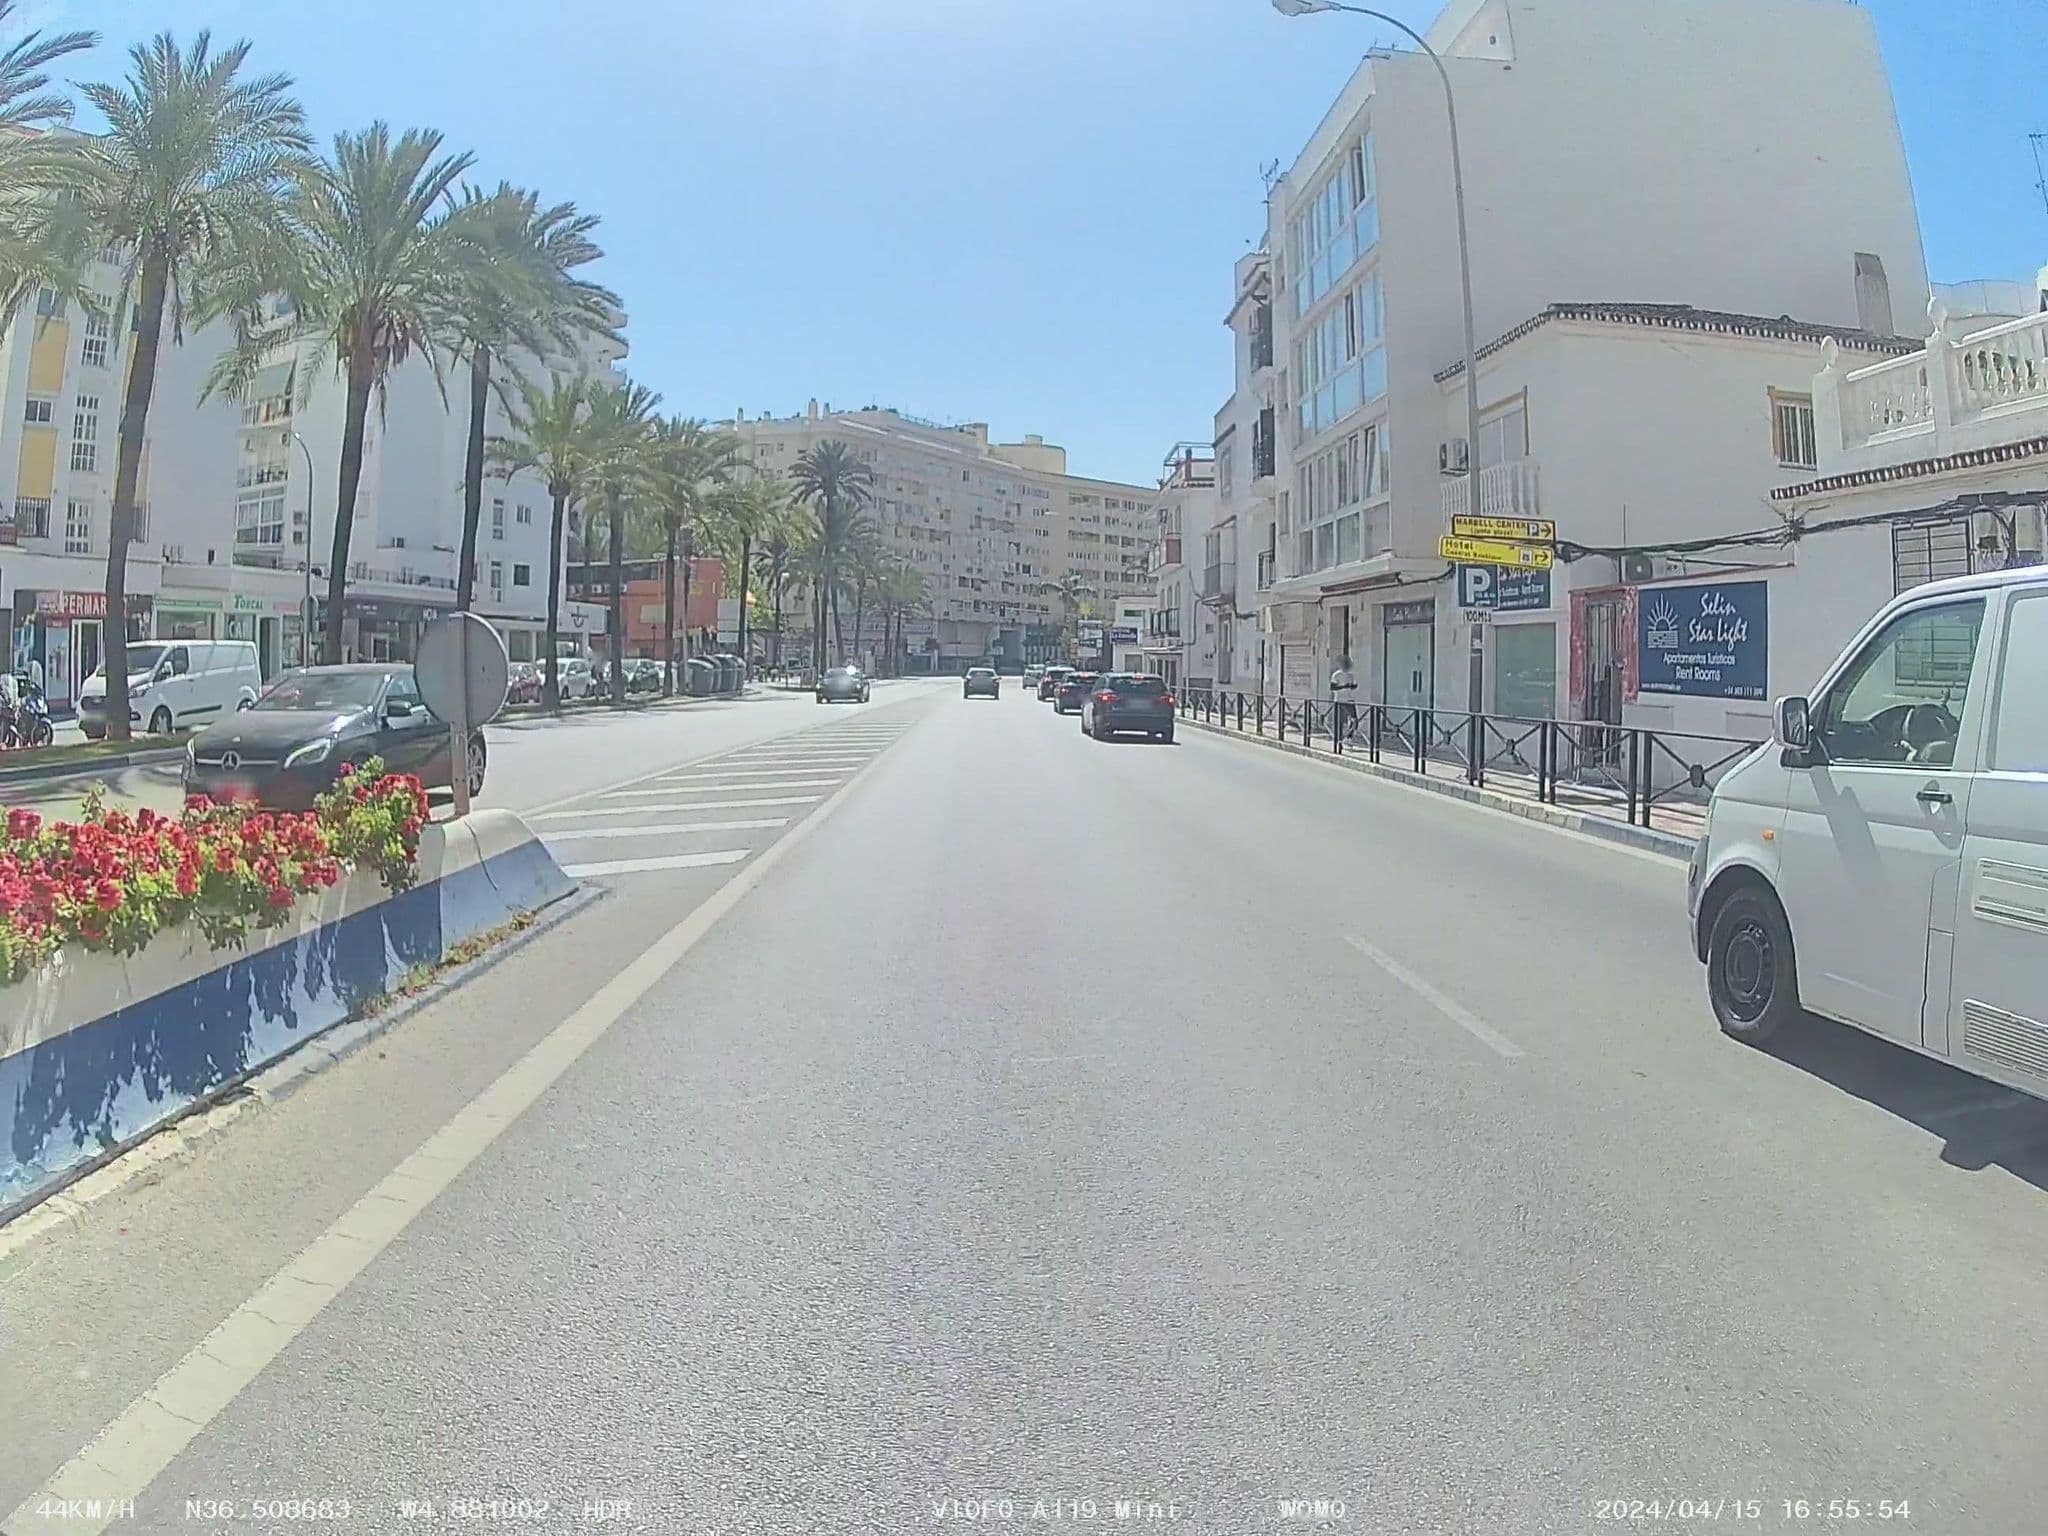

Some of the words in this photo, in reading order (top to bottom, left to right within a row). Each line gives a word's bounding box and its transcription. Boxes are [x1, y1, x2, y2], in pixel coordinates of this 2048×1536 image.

[1496, 520, 1527, 529] CENTER
[1445, 540, 1474, 551] Hotel
[1466, 568, 1491, 604] P
[1701, 592, 1736, 617] Selin
[1689, 618, 1714, 642] Star
[1717, 617, 1748, 652] Light
[1676, 666, 1693, 680] Rent
[1694, 666, 1720, 681] Rooms
